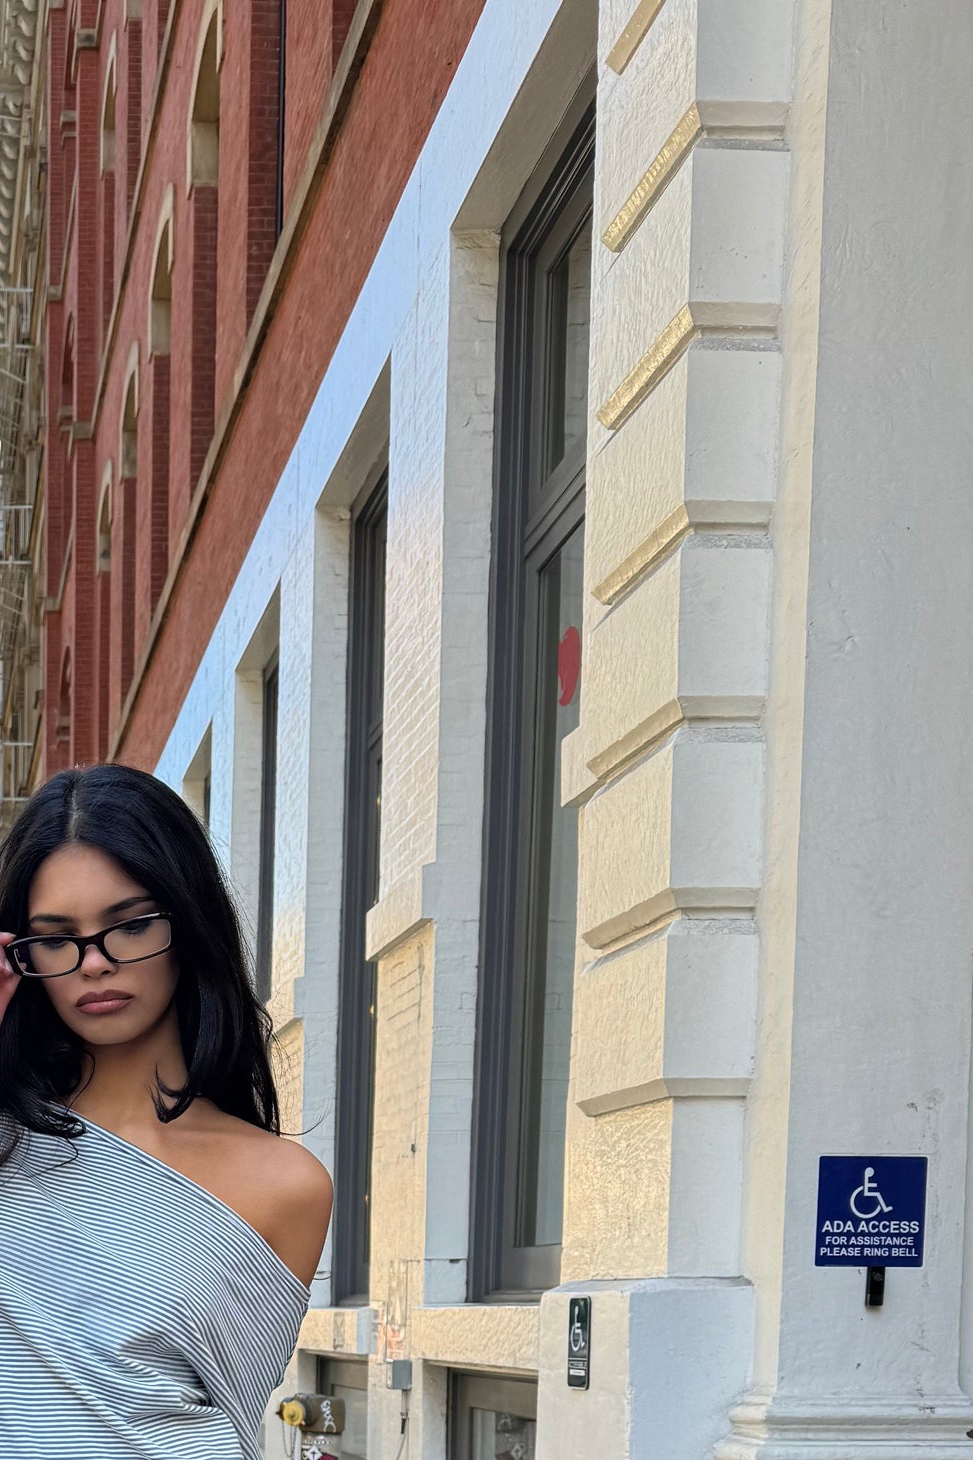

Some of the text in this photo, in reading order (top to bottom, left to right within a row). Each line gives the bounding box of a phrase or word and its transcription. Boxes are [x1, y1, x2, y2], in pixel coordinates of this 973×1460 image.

[821, 1220, 920, 1234] ADA ACCESS
[825, 1236, 914, 1246] FOR ASSISTANCE
[820, 1247, 918, 1257] PLEASE RING BELL
